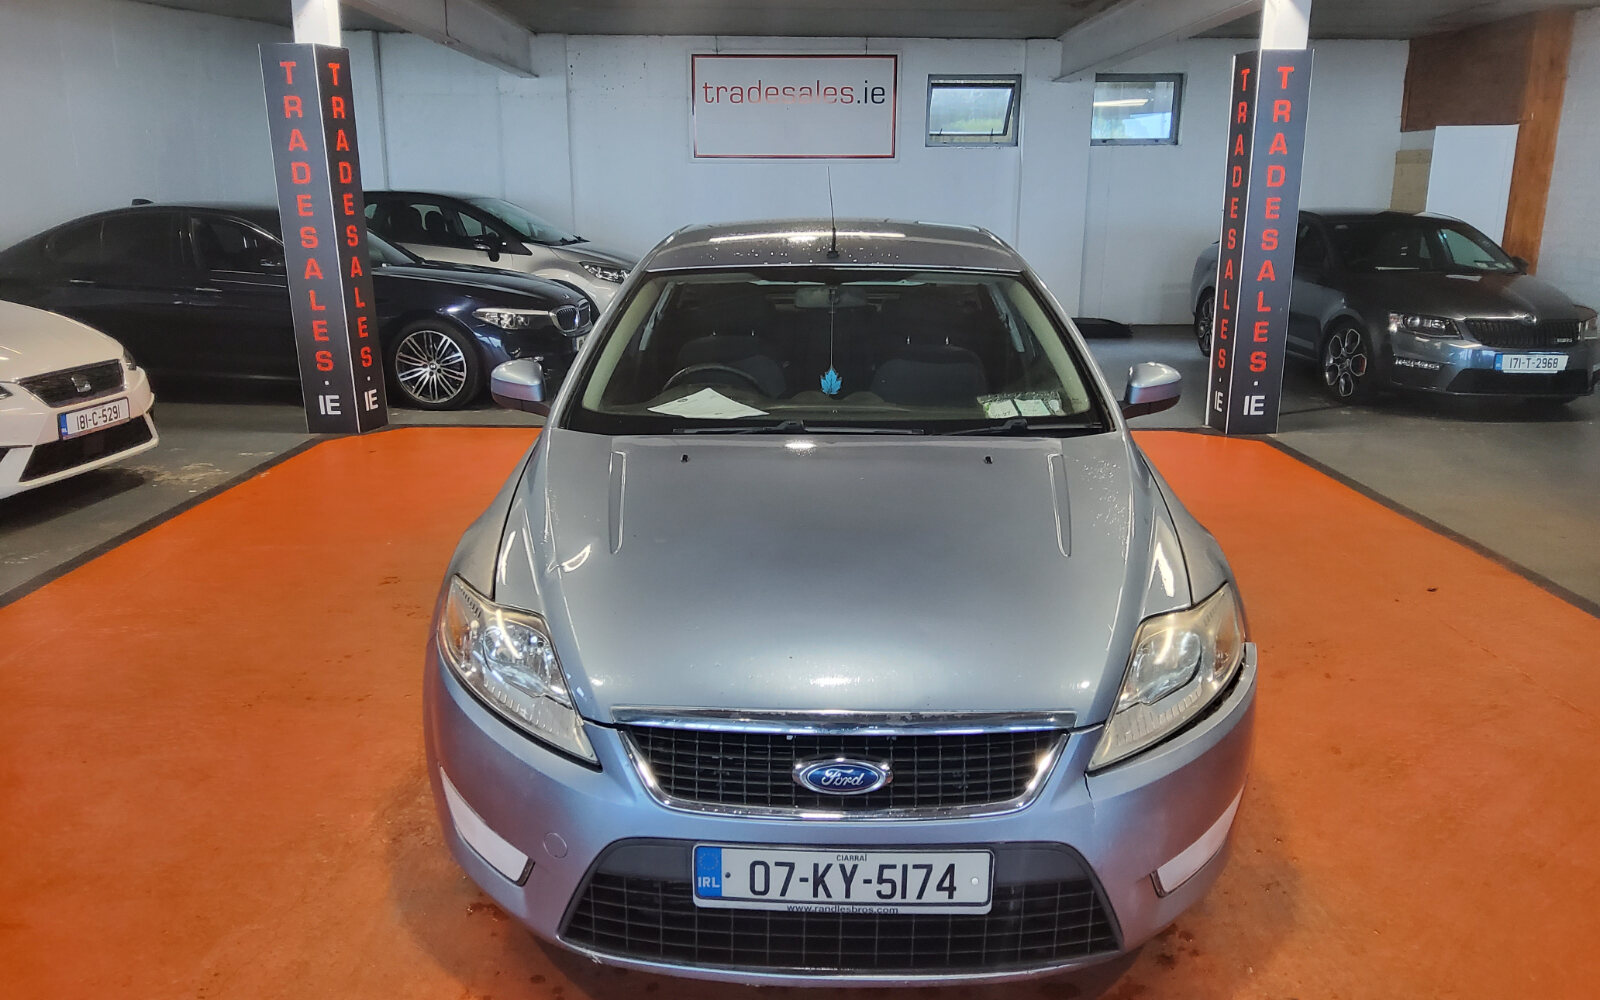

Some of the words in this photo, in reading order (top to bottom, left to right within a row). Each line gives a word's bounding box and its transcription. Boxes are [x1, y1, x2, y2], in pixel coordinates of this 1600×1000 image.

[702, 79, 886, 105] tradesales.ie
[1508, 357, 1559, 369] 171-T-2968
[76, 404, 121, 430] 181-C-5291
[821, 768, 865, 786] Ford
[698, 876, 720, 888] IRL
[749, 860, 957, 900] 07-KY-5174
[787, 904, 899, 914] www.randlesbros.com
